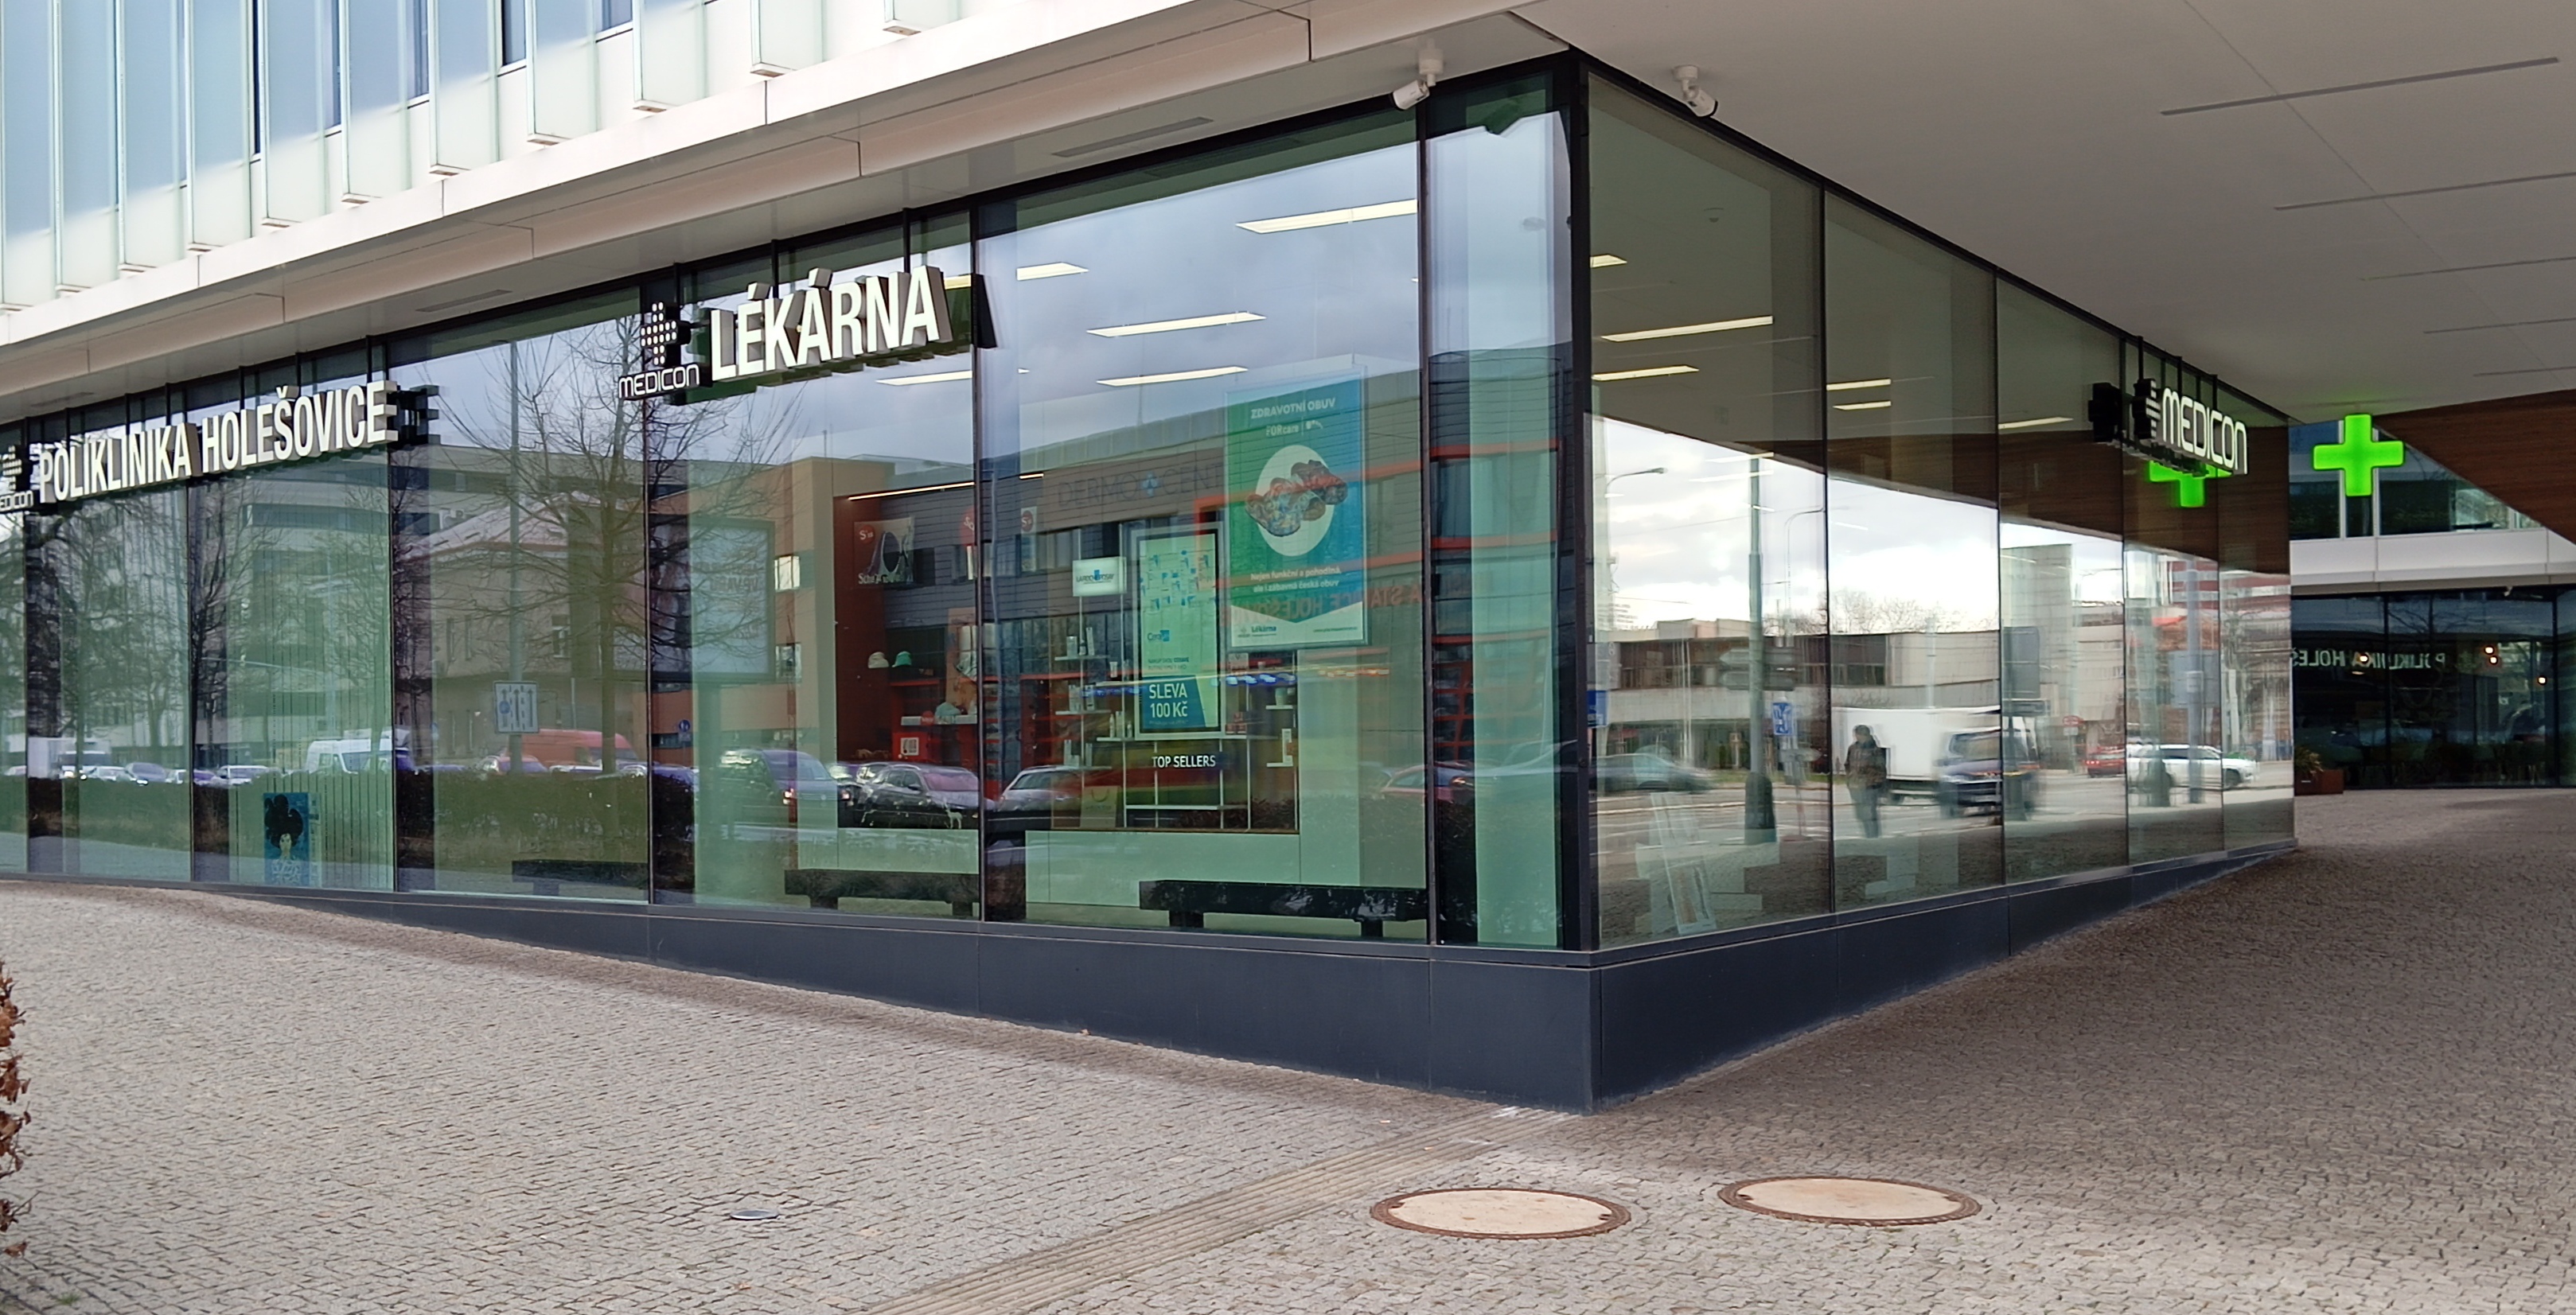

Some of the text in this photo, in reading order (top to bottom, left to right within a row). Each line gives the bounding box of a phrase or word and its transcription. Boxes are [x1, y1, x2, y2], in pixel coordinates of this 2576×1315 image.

[711, 264, 942, 381] LÉKÁRNA
[618, 364, 700, 399] MEDICON
[1251, 397, 1336, 419] ZDRAVOTNÍ OBUV
[2162, 387, 2248, 475] MEDICON
[39, 381, 390, 504] POLIKLINIKA HOLEŠOVICE
[0, 490, 34, 512] EDICON
[1148, 683, 1188, 698] SLEVA
[1150, 701, 1188, 718] 100 Kč
[1152, 755, 1216, 768] TOP SELLERS
